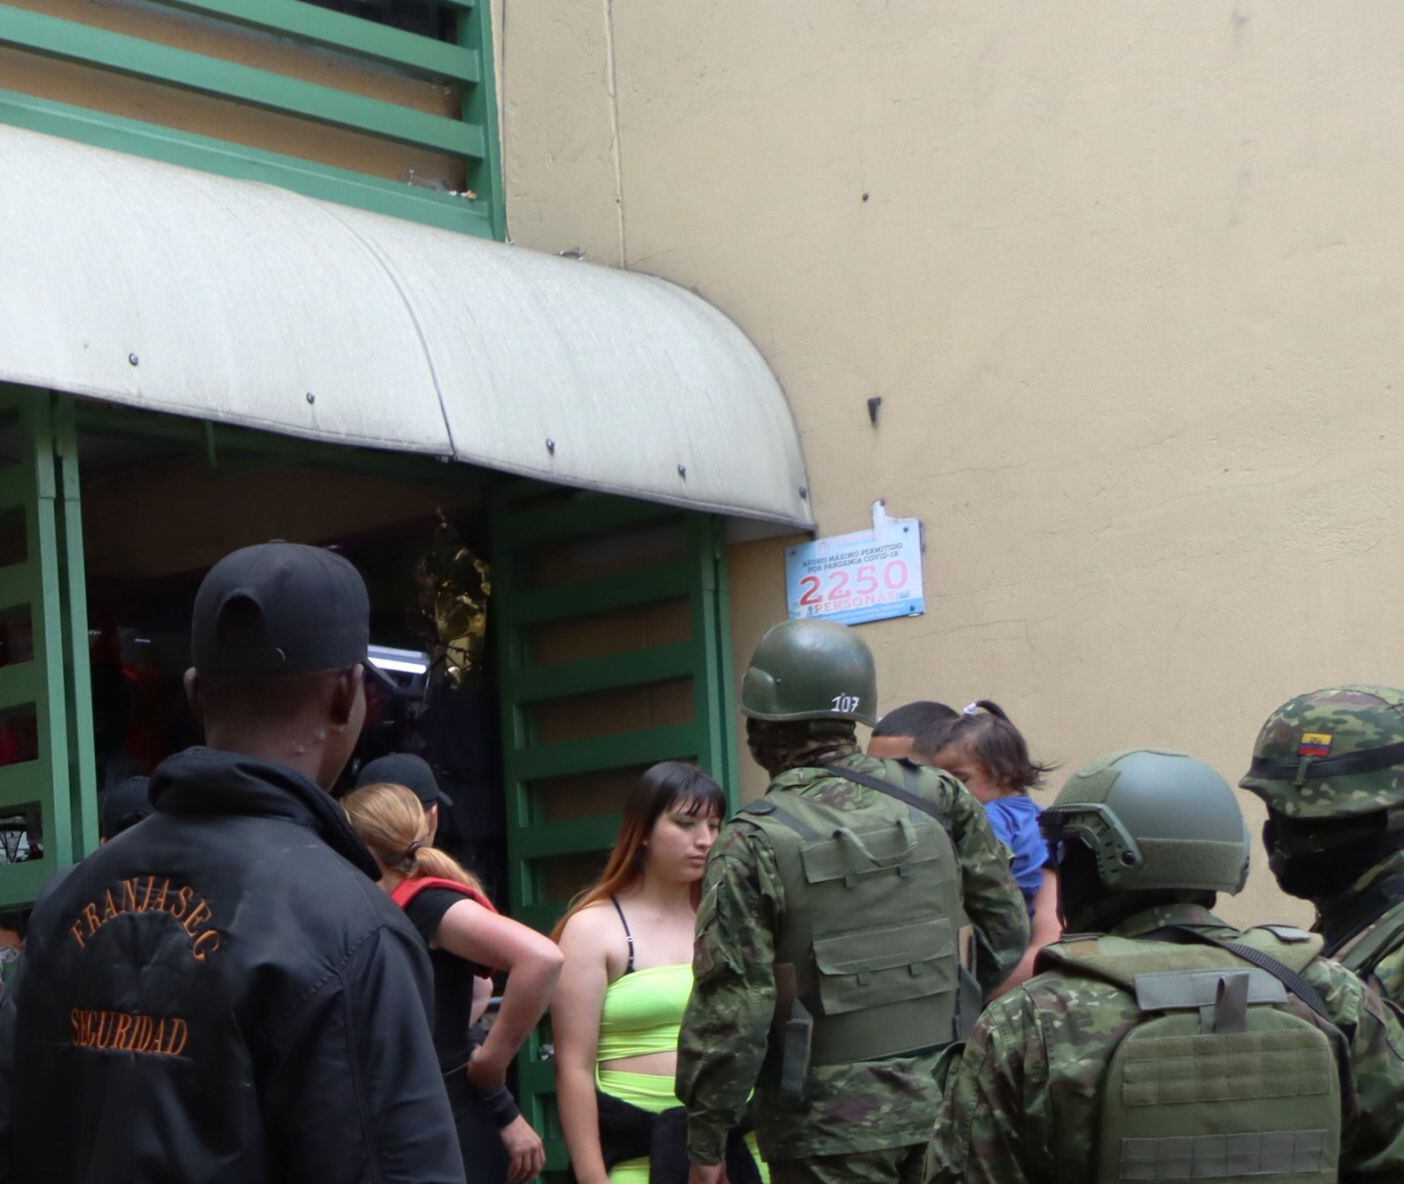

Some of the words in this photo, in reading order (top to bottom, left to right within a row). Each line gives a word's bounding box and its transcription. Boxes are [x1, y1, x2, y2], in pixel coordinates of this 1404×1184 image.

[861, 542, 903, 556] PERMITIDO
[799, 559, 909, 606] 2250
[814, 591, 898, 613] PERSONAS
[830, 696, 860, 713] 107
[70, 1007, 188, 1056] SEGURIDAD
